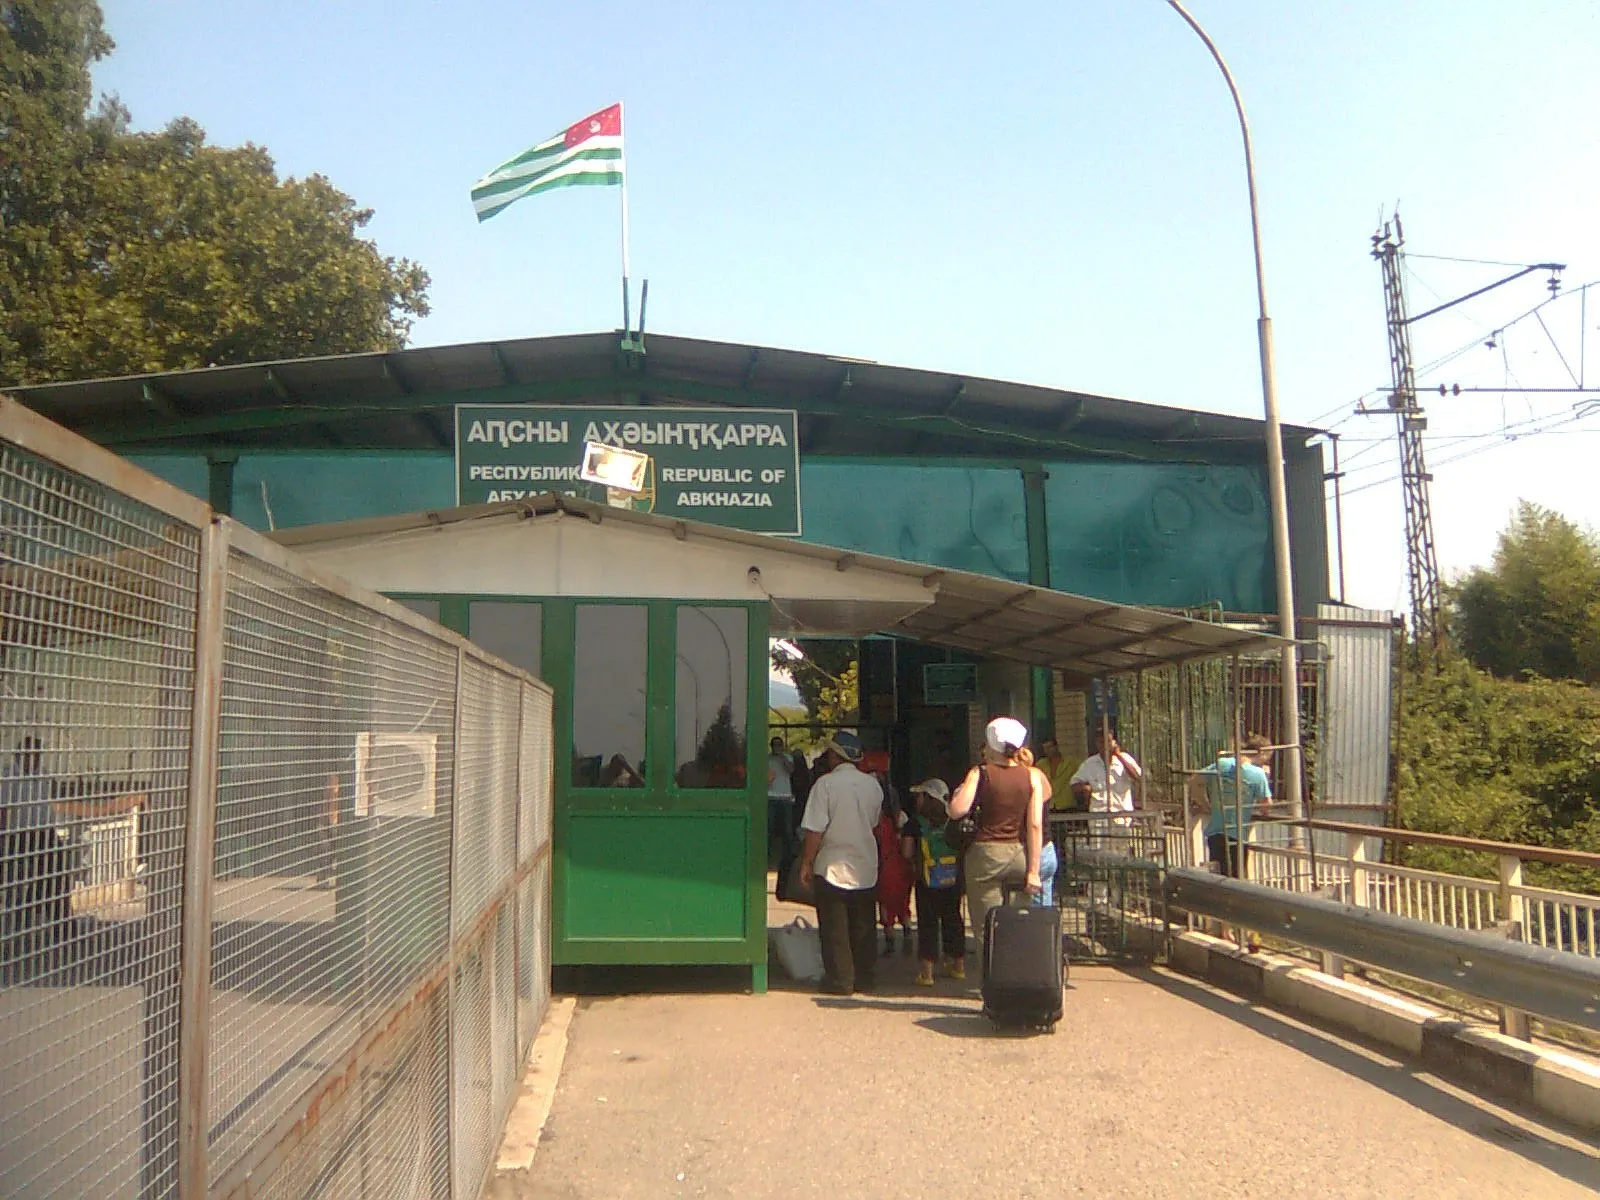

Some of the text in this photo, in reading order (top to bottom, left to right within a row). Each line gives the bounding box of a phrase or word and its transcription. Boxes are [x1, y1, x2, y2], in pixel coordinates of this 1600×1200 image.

[470, 465, 581, 480] РЕСПУБЛИК
[662, 468, 786, 483] REPUBLIC OF
[677, 492, 773, 507] ABKHAZIA
